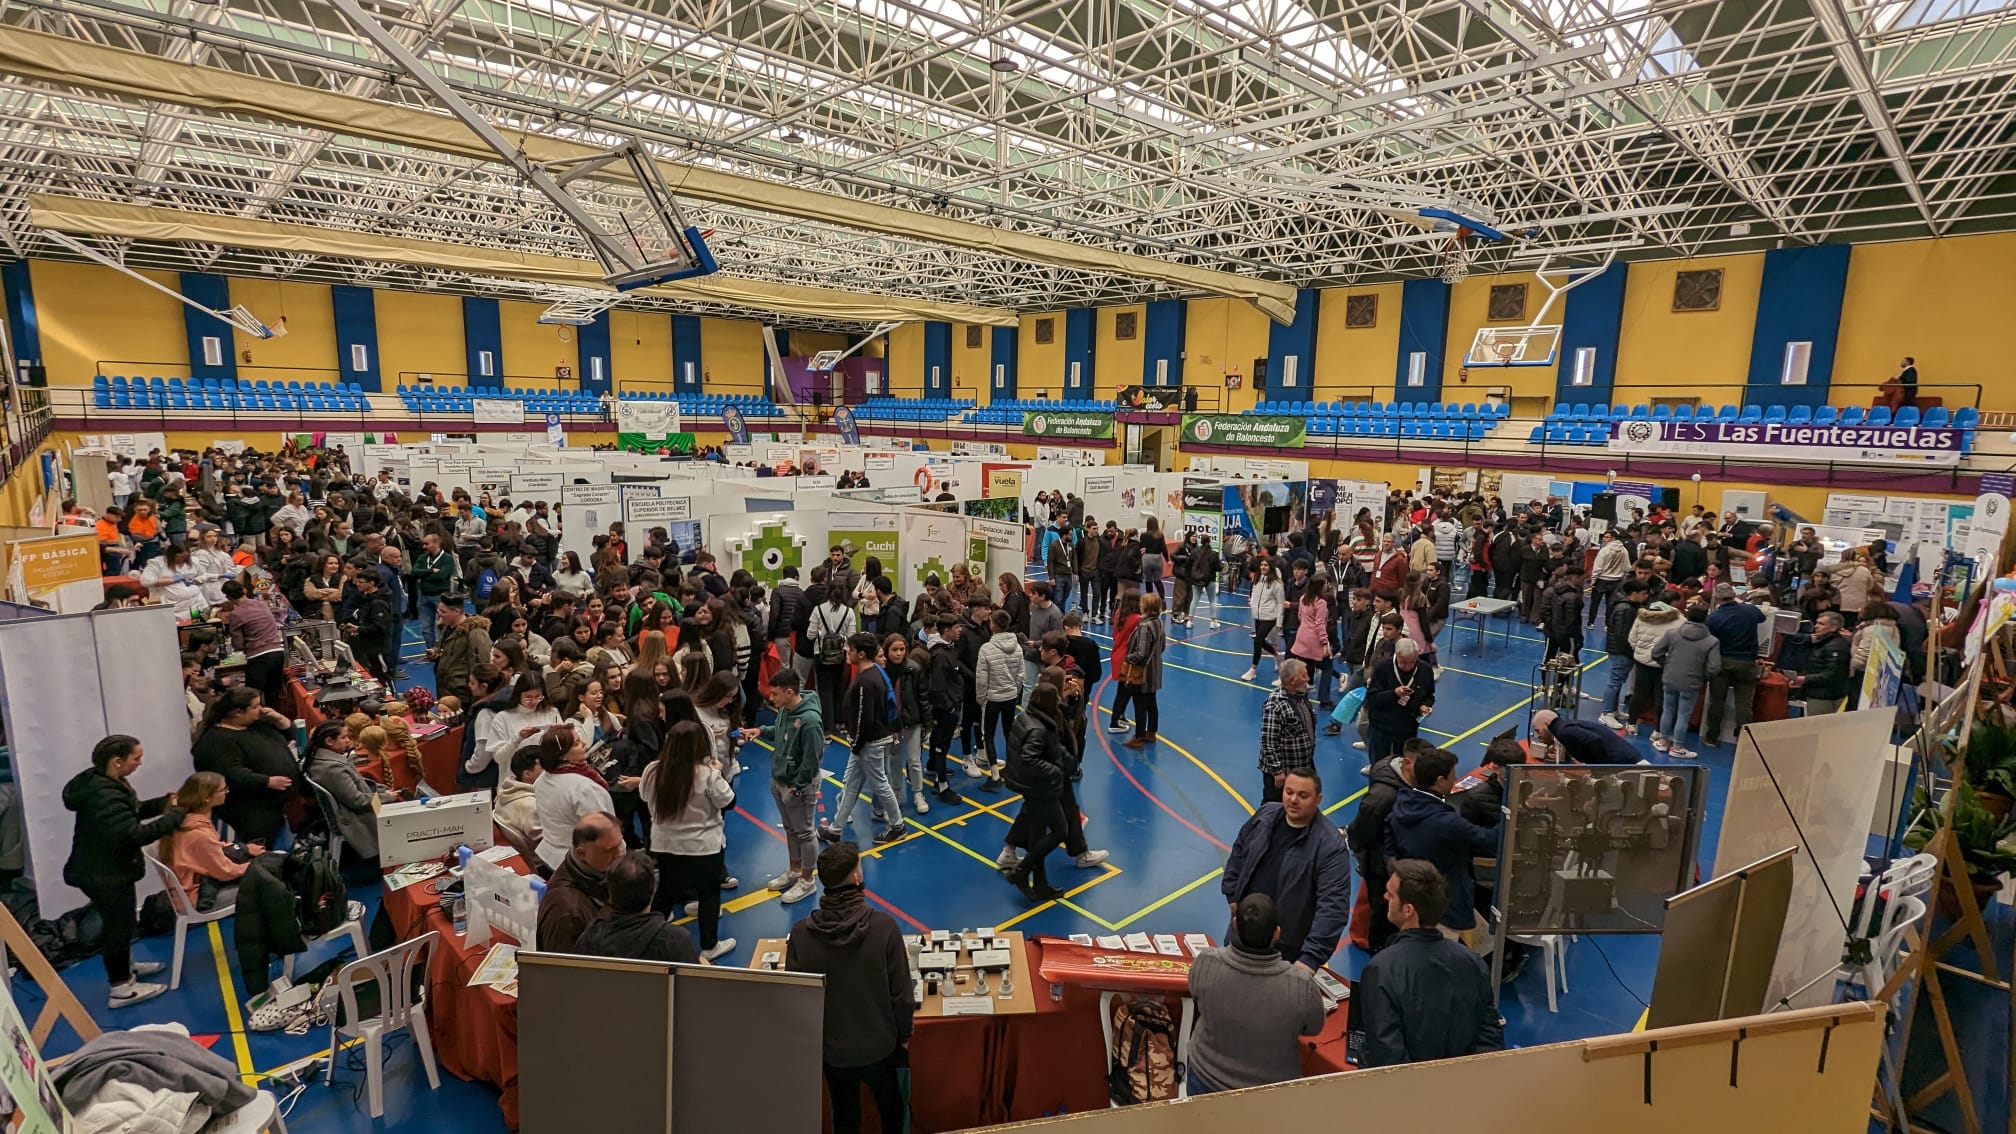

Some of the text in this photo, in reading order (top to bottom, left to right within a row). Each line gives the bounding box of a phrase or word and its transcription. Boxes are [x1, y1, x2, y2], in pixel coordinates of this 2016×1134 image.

[1047, 417, 1102, 427] Federación Andaluza
[1213, 421, 1290, 433] Federación Andaluza
[1063, 427, 1092, 435] Baloncesto
[1663, 422, 1953, 448] IES Las Fuentezuelas
[1225, 432, 1275, 443] de Baloncesto
[994, 477, 1016, 485] vuela
[1223, 514, 1242, 530] UJA
[1184, 524, 1219, 534] moto
[865, 540, 896, 551] Cuchi
[407, 825, 464, 839] PRACTI-MAN
